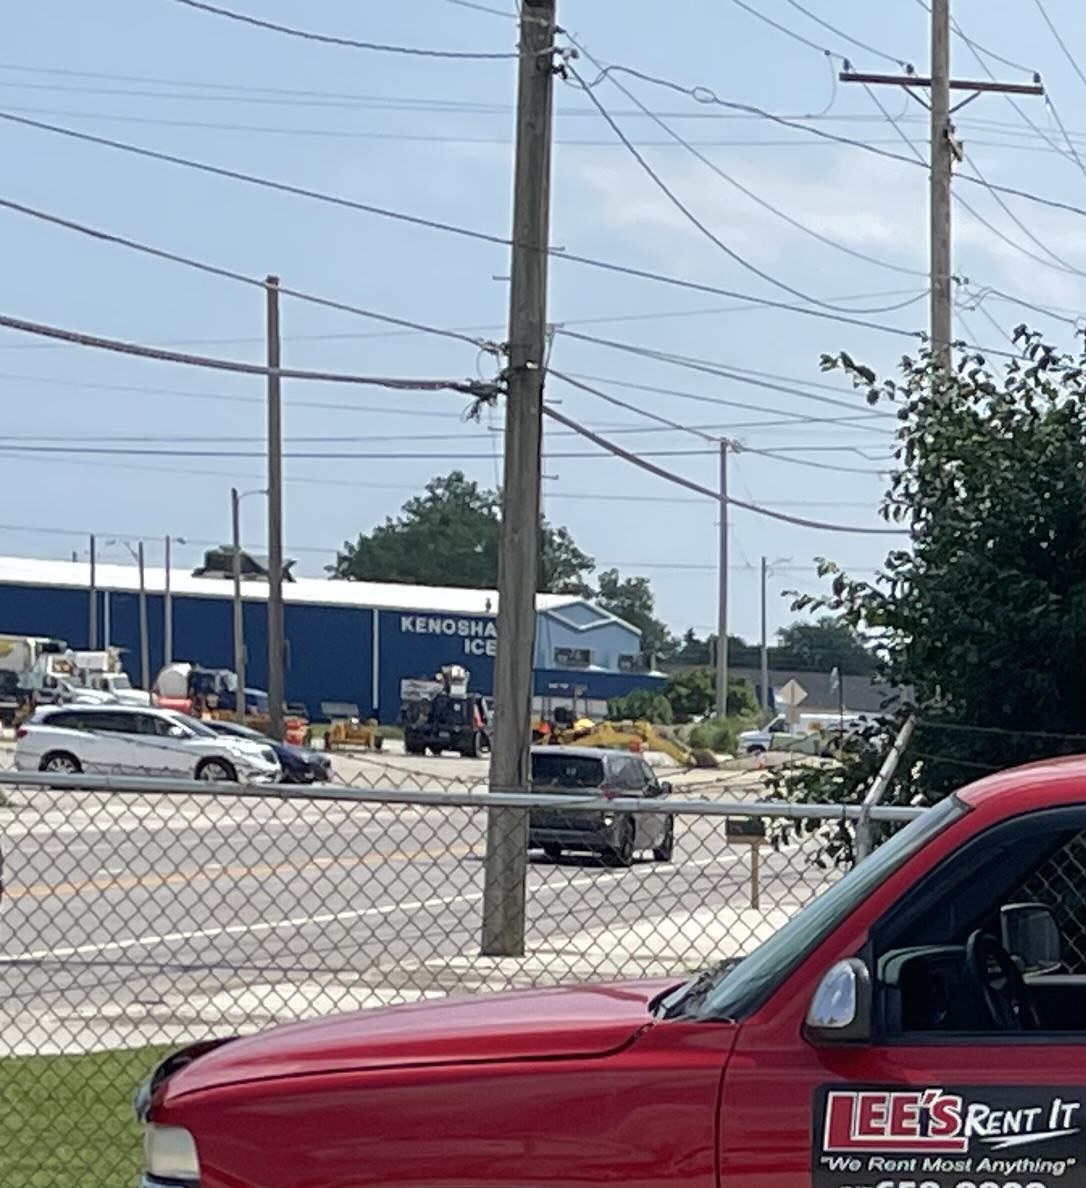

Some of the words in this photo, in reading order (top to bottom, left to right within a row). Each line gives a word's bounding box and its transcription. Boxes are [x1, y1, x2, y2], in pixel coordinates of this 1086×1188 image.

[400, 616, 498, 638] KENOSHA
[464, 638, 497, 657] ICE
[823, 1089, 968, 1152] LEE'S
[868, 1156, 917, 1172] Rent
[922, 1157, 972, 1173] Most
[976, 1157, 1076, 1177] Anything"
